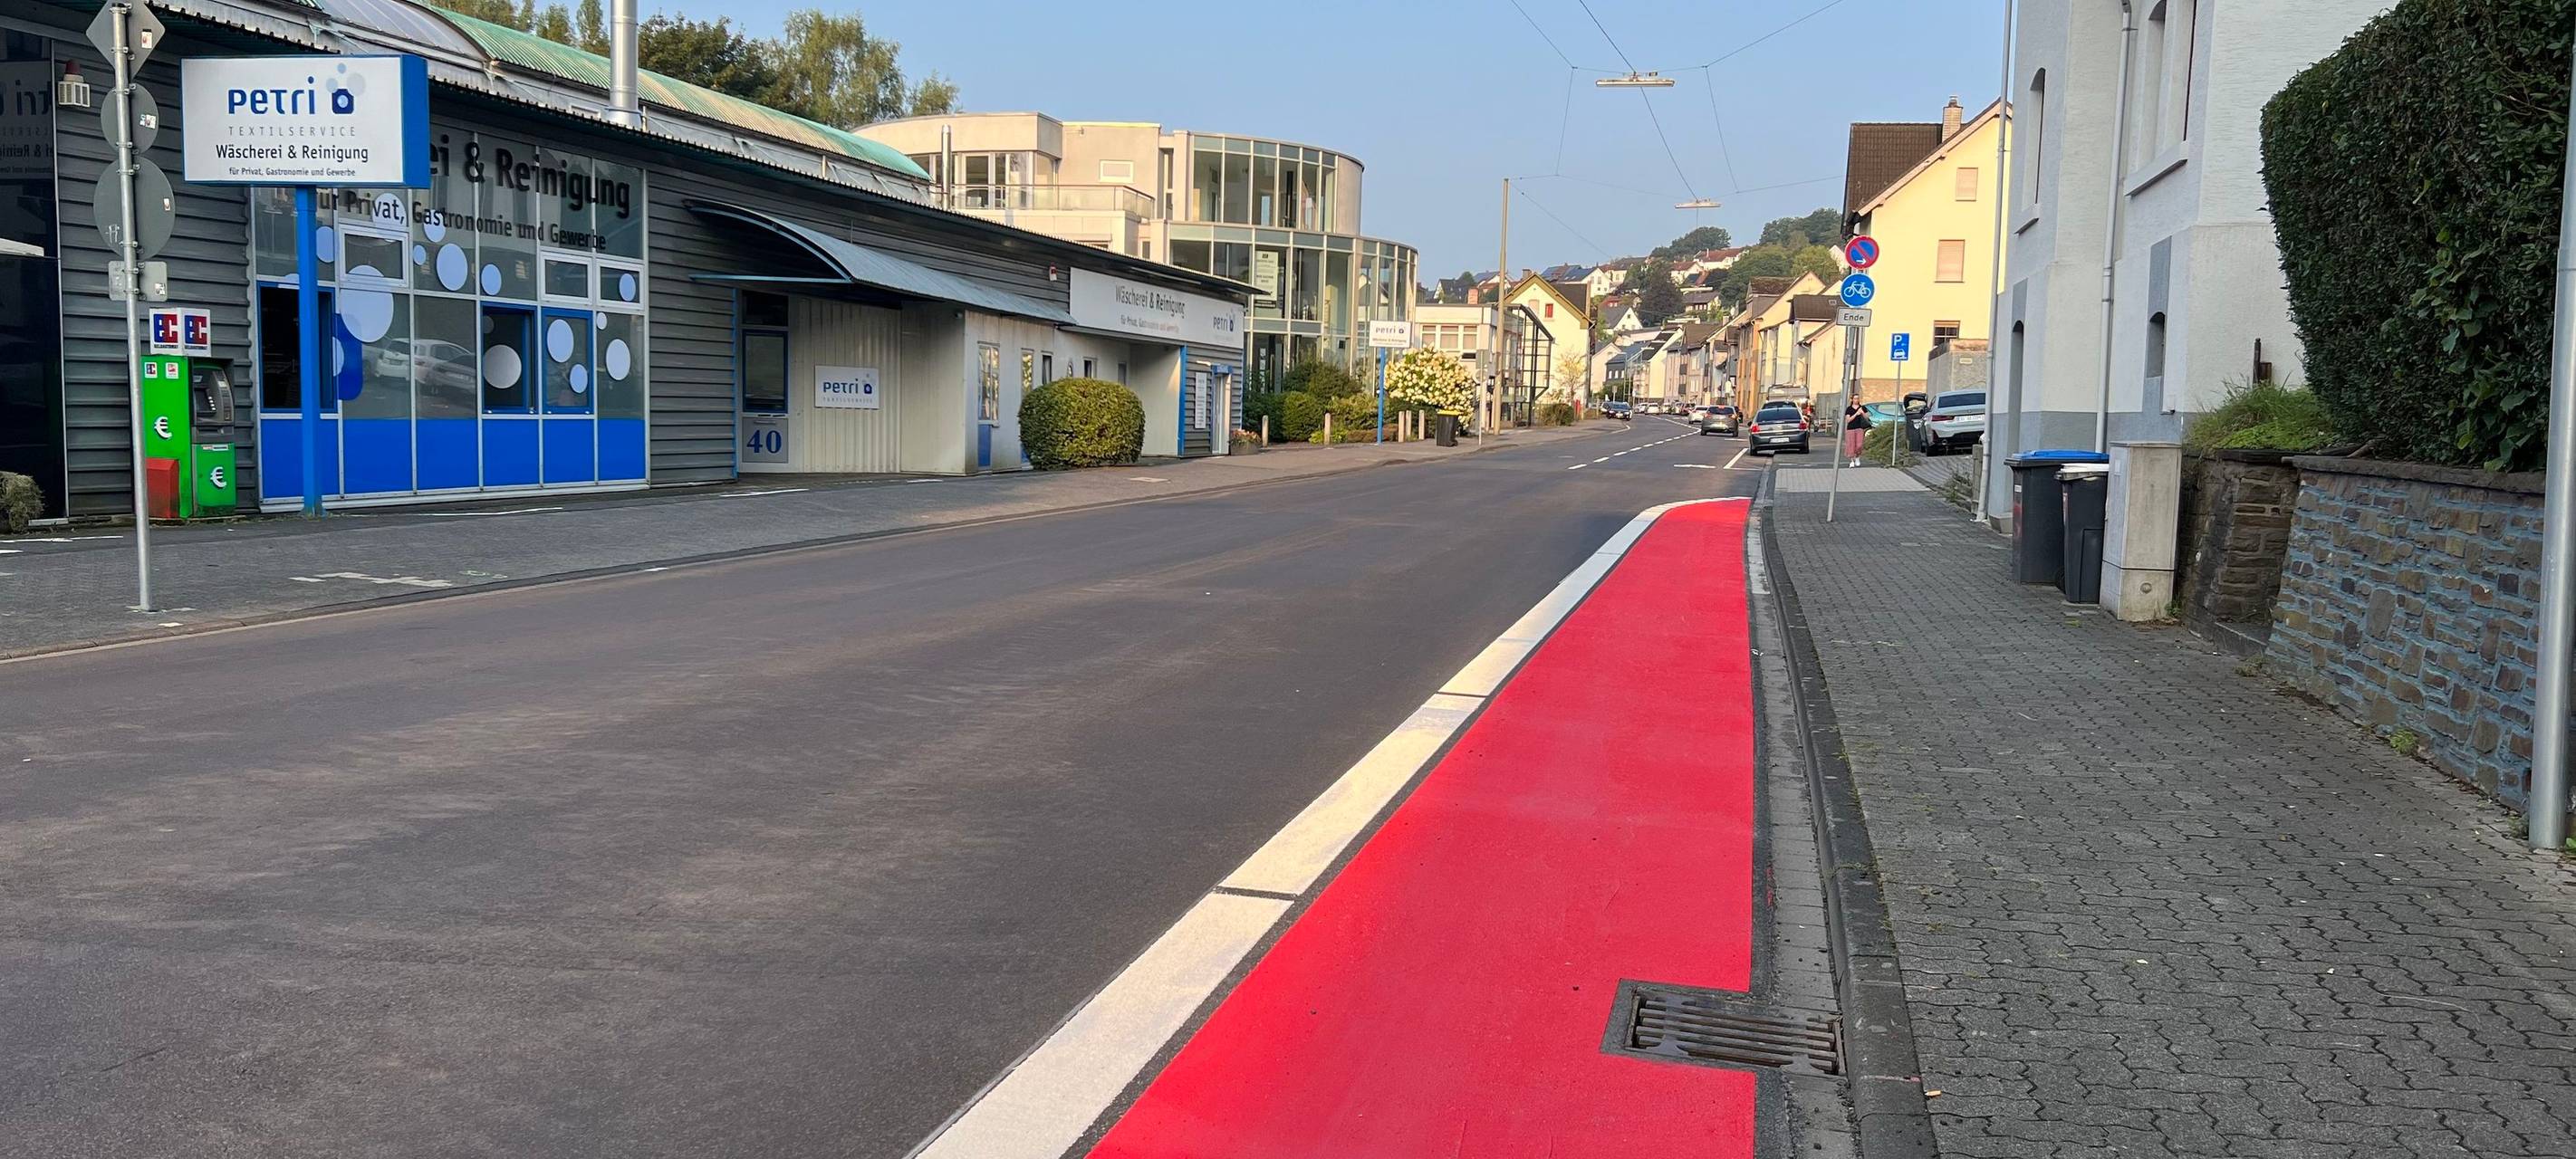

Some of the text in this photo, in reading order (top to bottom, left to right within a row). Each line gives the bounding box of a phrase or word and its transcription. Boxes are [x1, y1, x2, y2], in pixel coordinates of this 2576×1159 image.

[227, 76, 316, 115] petri
[228, 126, 356, 137] TEXTILSERVICE
[216, 144, 369, 163] Wäscherei & Reinigung
[229, 167, 356, 177] für Privat, Gastronomie und Gewerbe
[465, 141, 485, 184] &
[496, 147, 630, 219] Reinigung
[347, 190, 405, 225] Privat,
[412, 201, 512, 237] Gastronomie
[518, 222, 544, 242] und
[1115, 284, 1185, 319] Wäscherei & Reinigung
[1843, 313, 1864, 321] Ende
[1894, 335, 1902, 346] P
[822, 378, 859, 394] petri
[154, 416, 173, 438] €
[746, 429, 782, 454] 40
[210, 466, 227, 488] €
